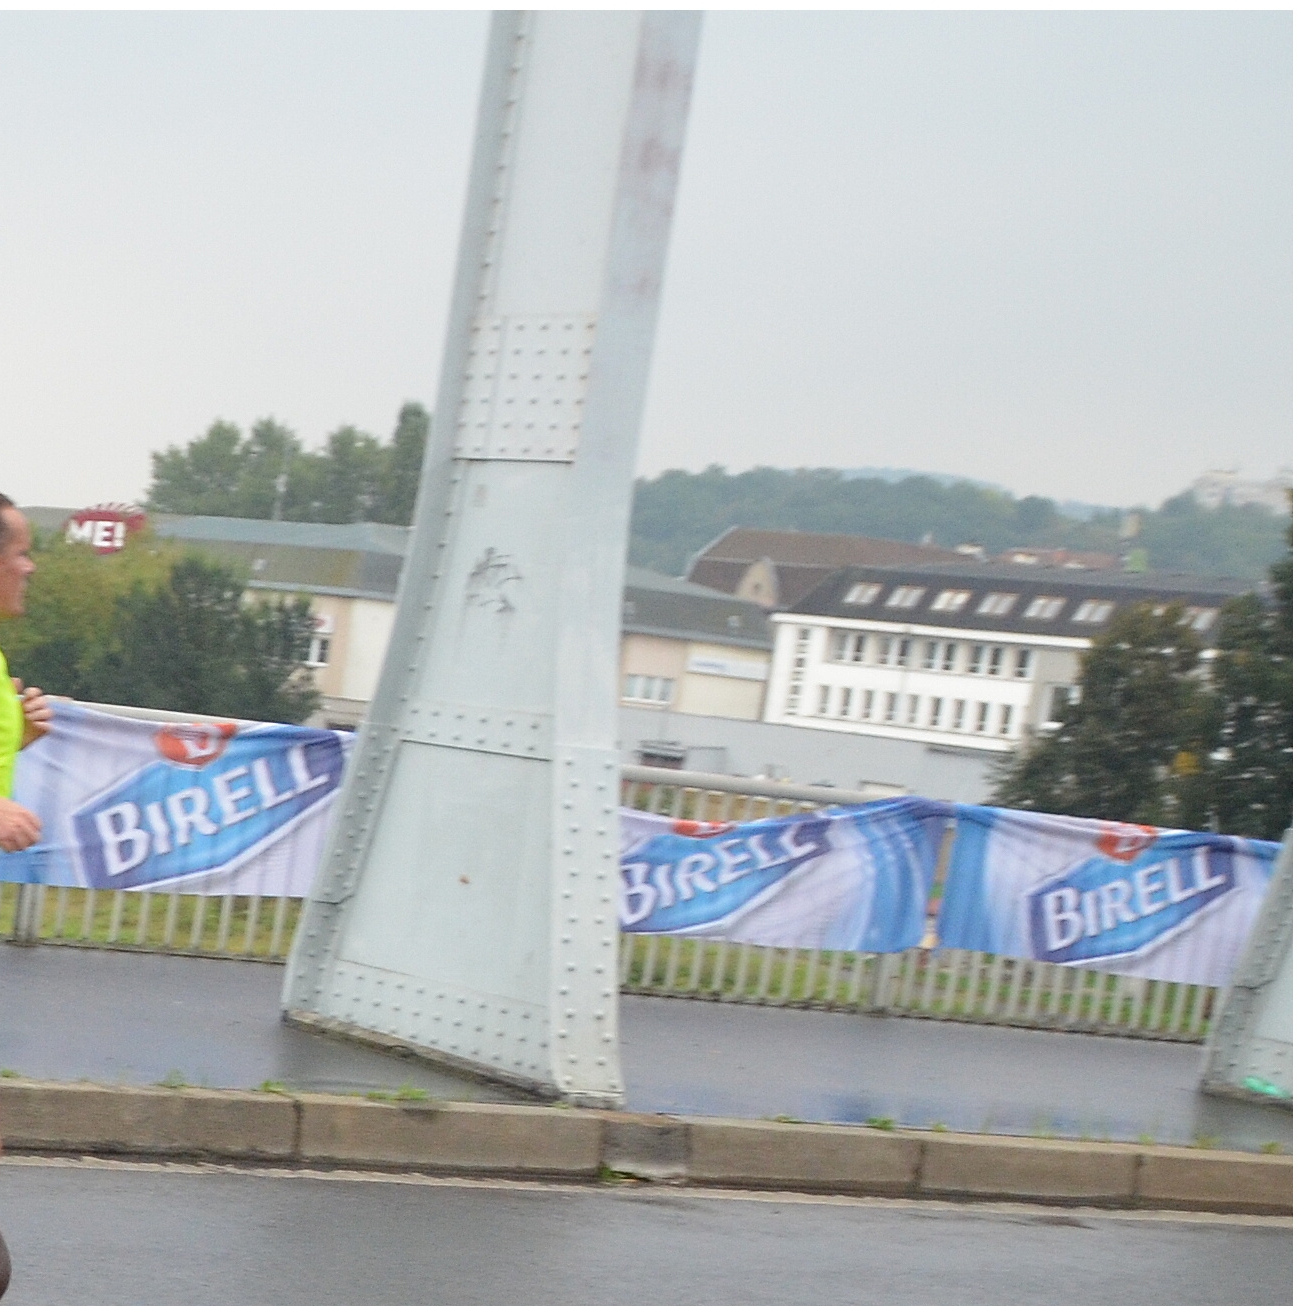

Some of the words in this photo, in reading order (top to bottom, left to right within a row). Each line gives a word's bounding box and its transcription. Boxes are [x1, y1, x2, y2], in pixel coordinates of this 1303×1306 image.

[95, 744, 329, 876] BIRELL
[619, 822, 818, 926] BIRELL
[1043, 845, 1227, 951] BIRELL
